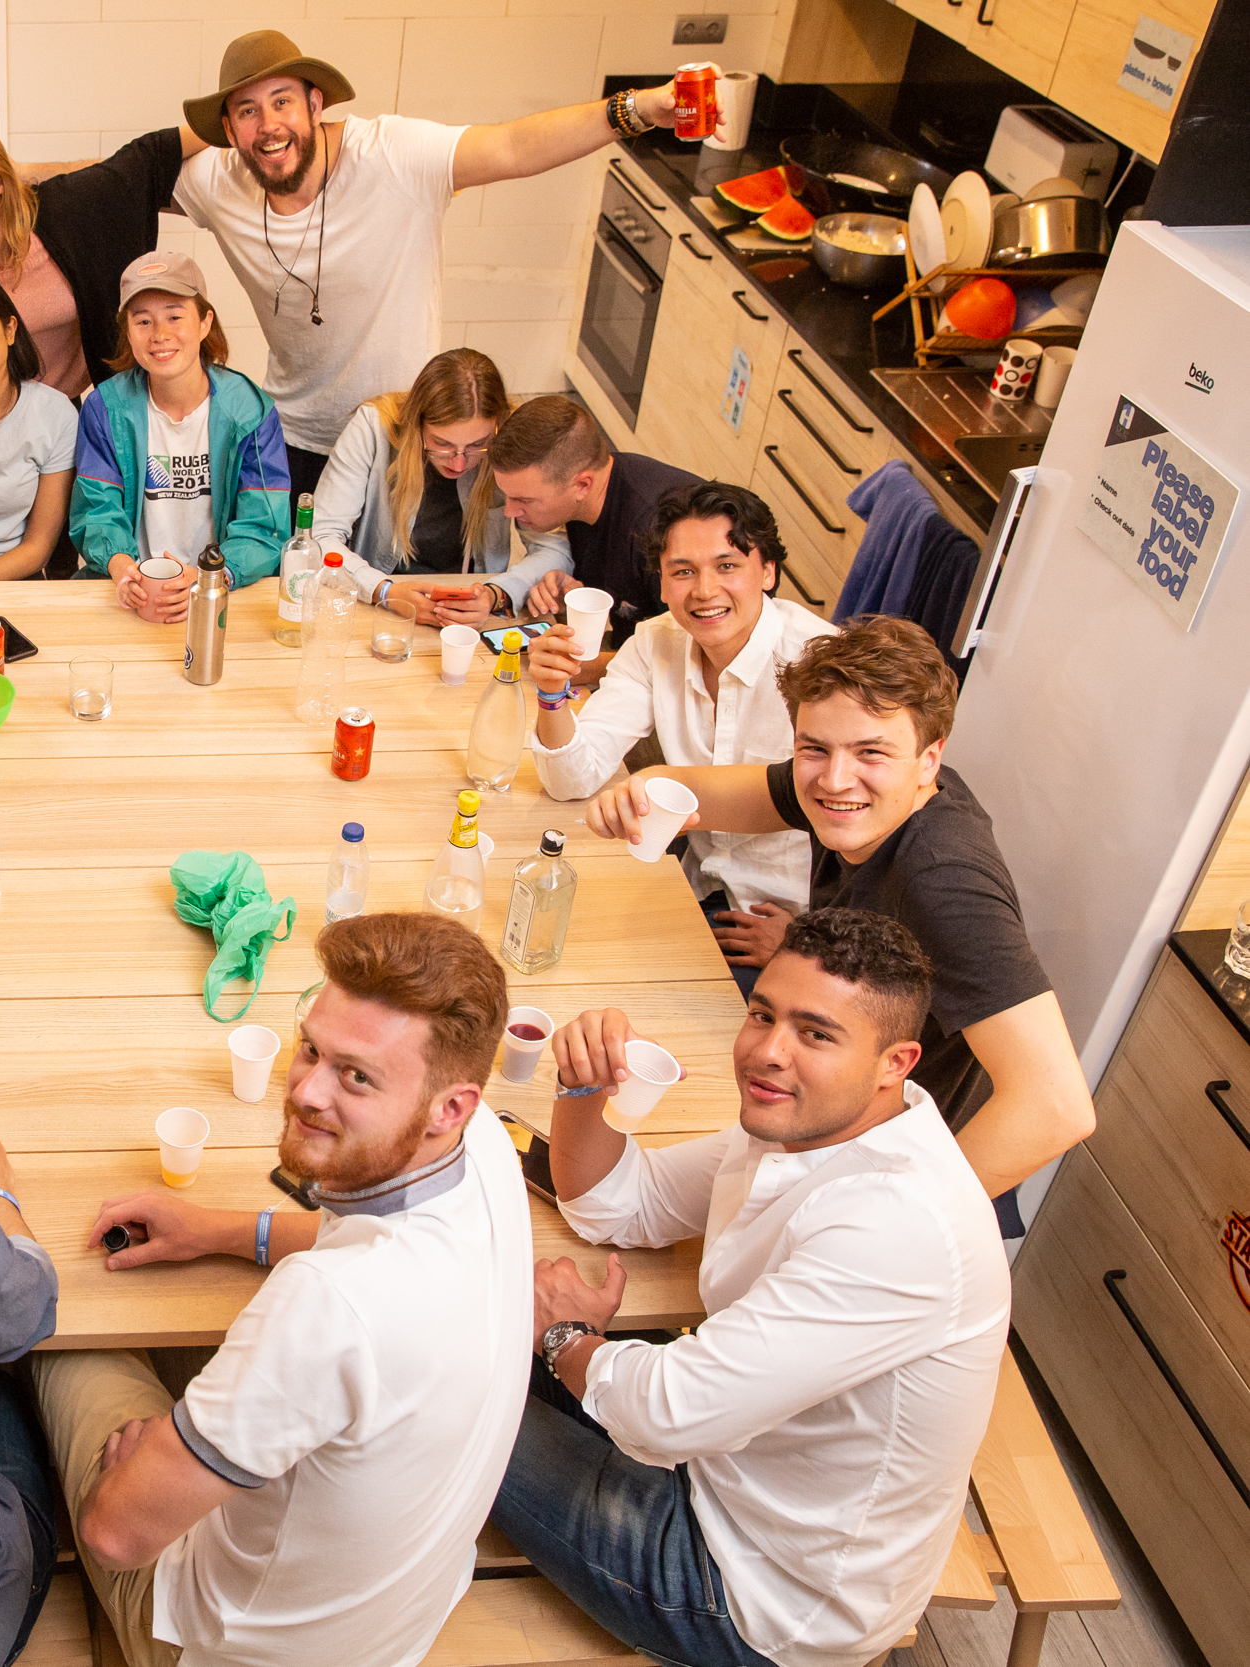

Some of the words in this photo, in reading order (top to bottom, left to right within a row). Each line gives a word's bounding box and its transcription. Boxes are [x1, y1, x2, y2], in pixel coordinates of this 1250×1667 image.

[1122, 63, 1145, 81] plates
[1151, 76, 1174, 96] bowls
[1189, 362, 1214, 389] beko
[172, 454, 210, 468] RUGB
[172, 468, 201, 476] WORLD
[173, 475, 211, 489] 201
[1100, 478, 1118, 498] Name
[1142, 439, 1215, 520] Please
[1094, 497, 1112, 518] Check
[1112, 512, 1122, 526] out
[1121, 519, 1135, 537] date
[1151, 481, 1209, 549] label
[1141, 517, 1198, 573] your
[1137, 542, 1189, 601] food
